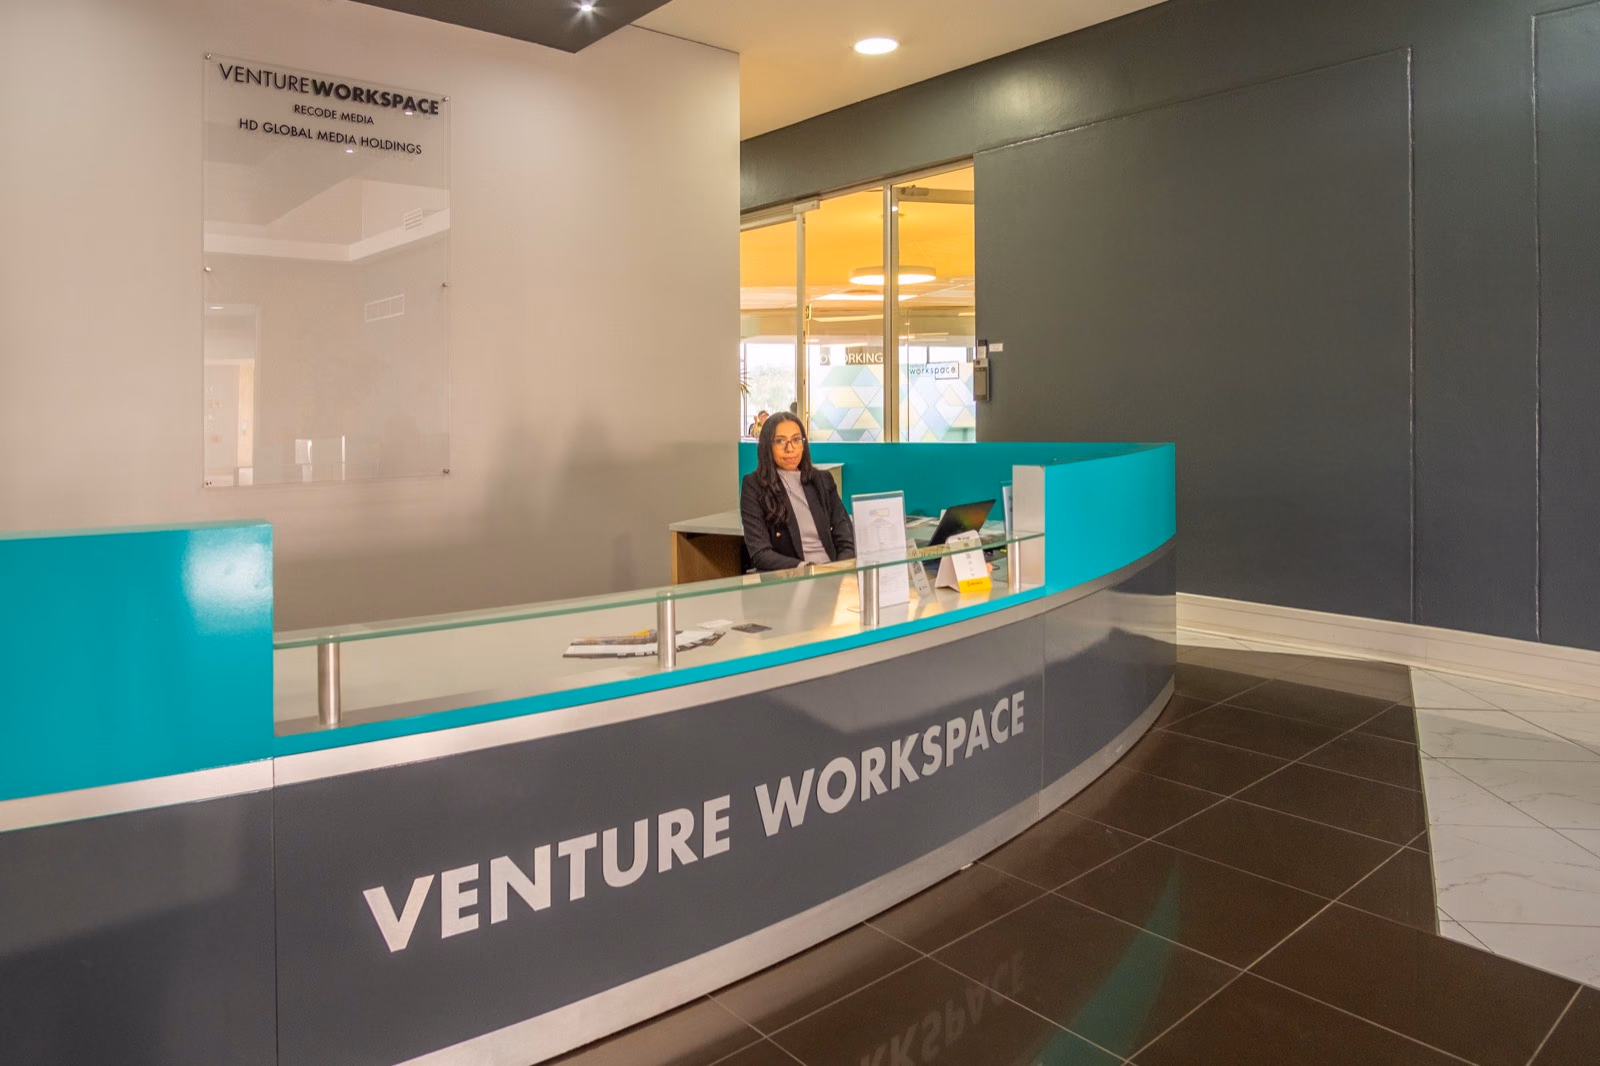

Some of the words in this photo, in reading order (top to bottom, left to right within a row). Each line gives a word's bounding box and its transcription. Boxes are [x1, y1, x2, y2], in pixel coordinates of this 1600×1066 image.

[294, 104, 337, 120] RECODE
[340, 111, 375, 125] MEDIA
[239, 118, 259, 132] HD
[263, 121, 313, 139] GLOBAL
[317, 130, 357, 146] MEDIA
[360, 136, 422, 155] HOLDINGS
[910, 366, 956, 377] workspace
[363, 794, 731, 953] VENTURE
[755, 691, 1025, 836] WORKSPACE
